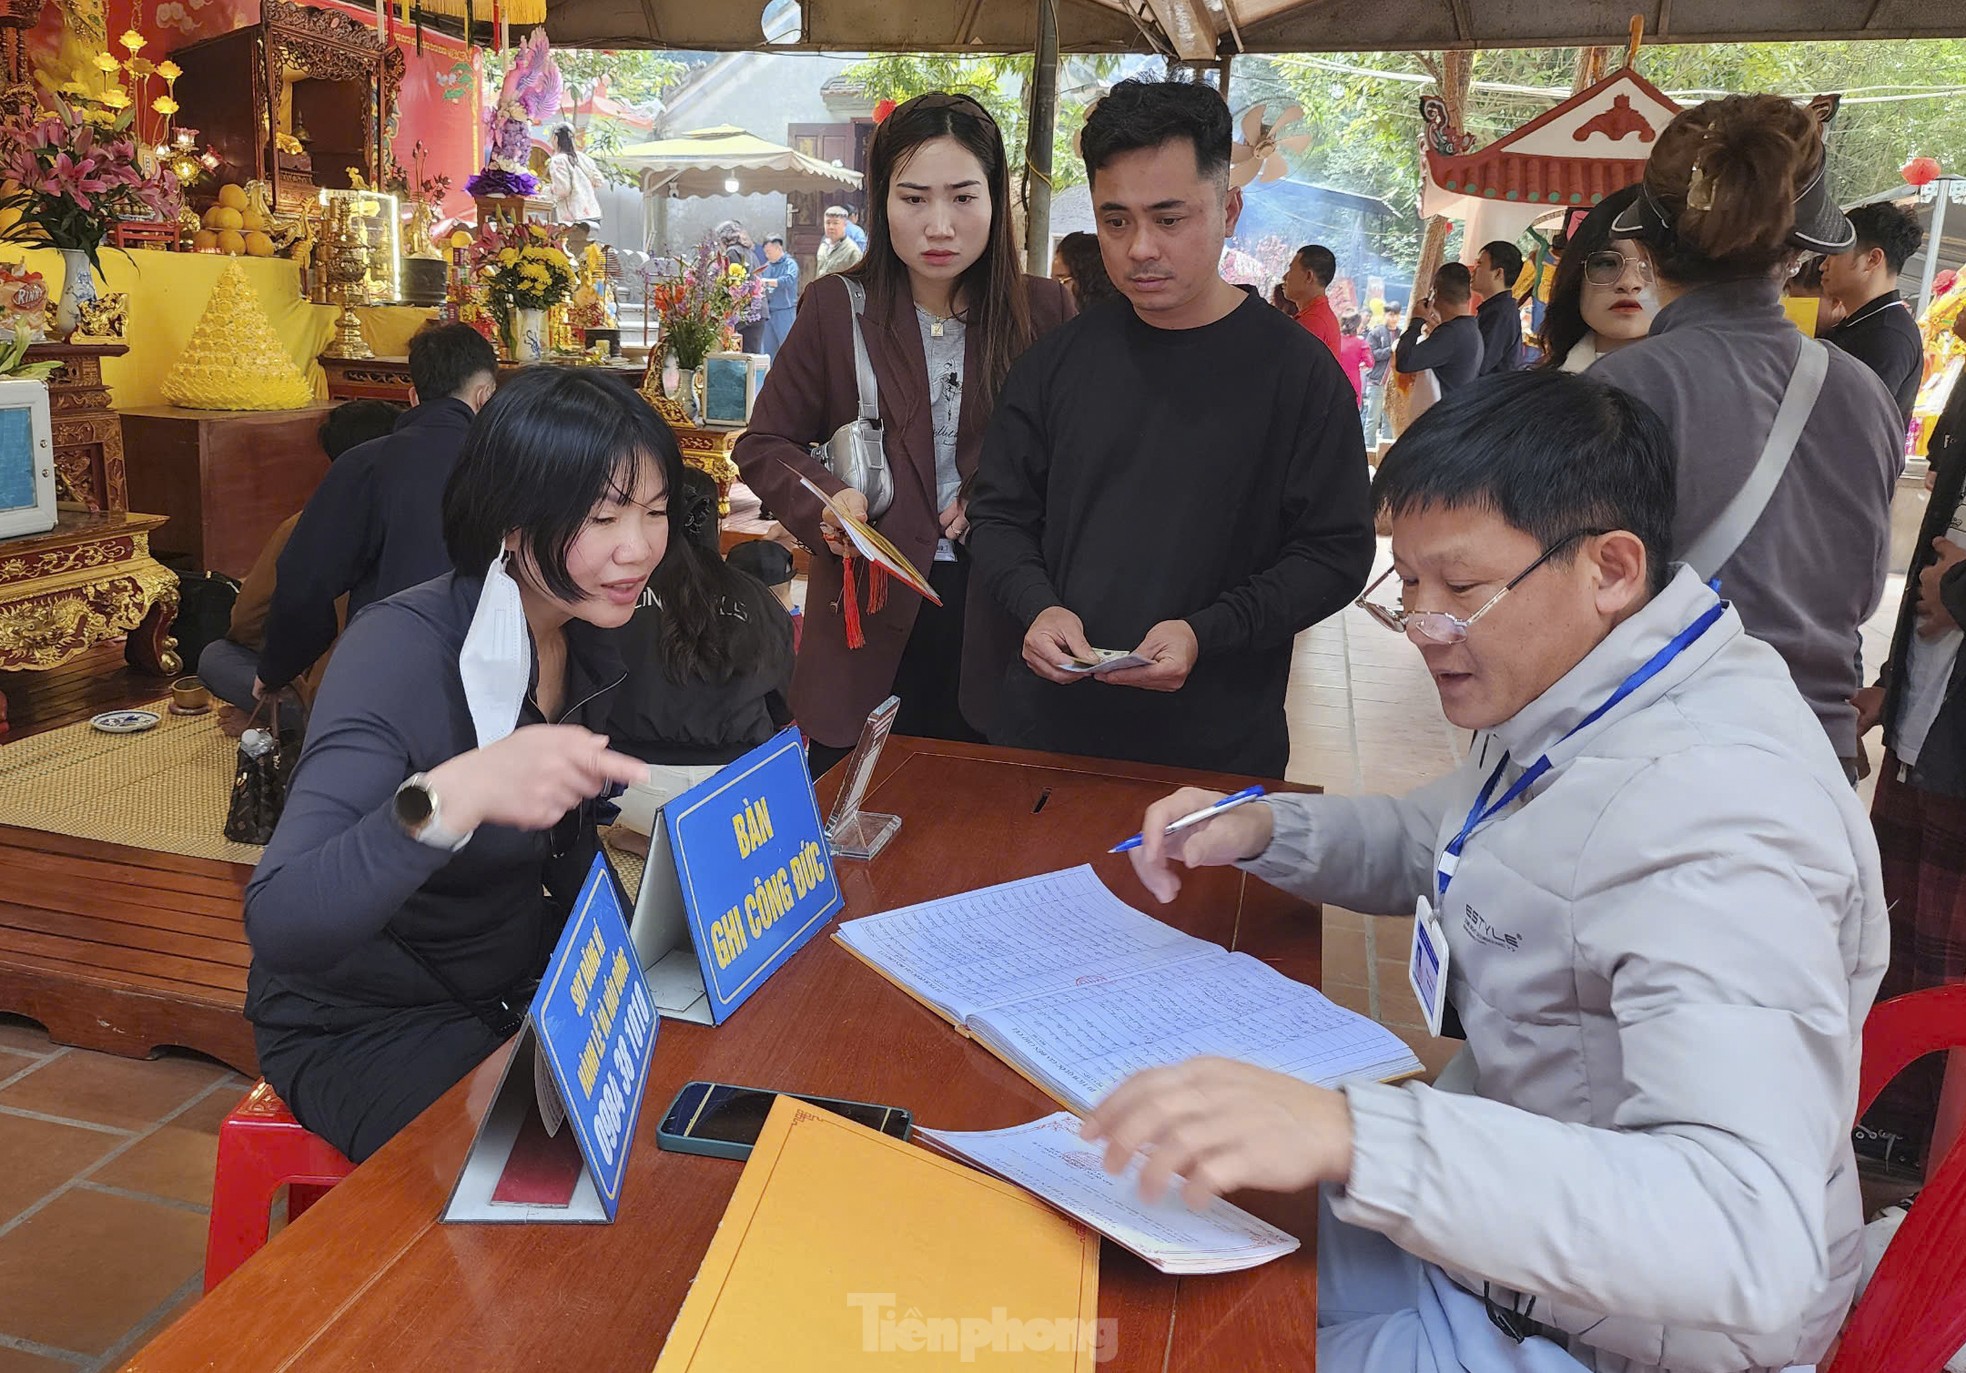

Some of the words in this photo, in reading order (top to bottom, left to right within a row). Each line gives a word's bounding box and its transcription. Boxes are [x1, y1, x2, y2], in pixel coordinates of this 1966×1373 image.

[732, 796, 774, 859] BÀN
[579, 937, 601, 992] ĐĂNG
[592, 917, 606, 959] KÍ
[711, 905, 748, 970] GHI
[744, 867, 795, 940] CÔNG
[789, 840, 825, 900] ĐỨC
[577, 1036, 601, 1101] HÀNH
[597, 997, 613, 1040] VÀ
[594, 1070, 626, 1166] 0984
[613, 1034, 635, 1096] 38
[624, 981, 650, 1060] 1010
